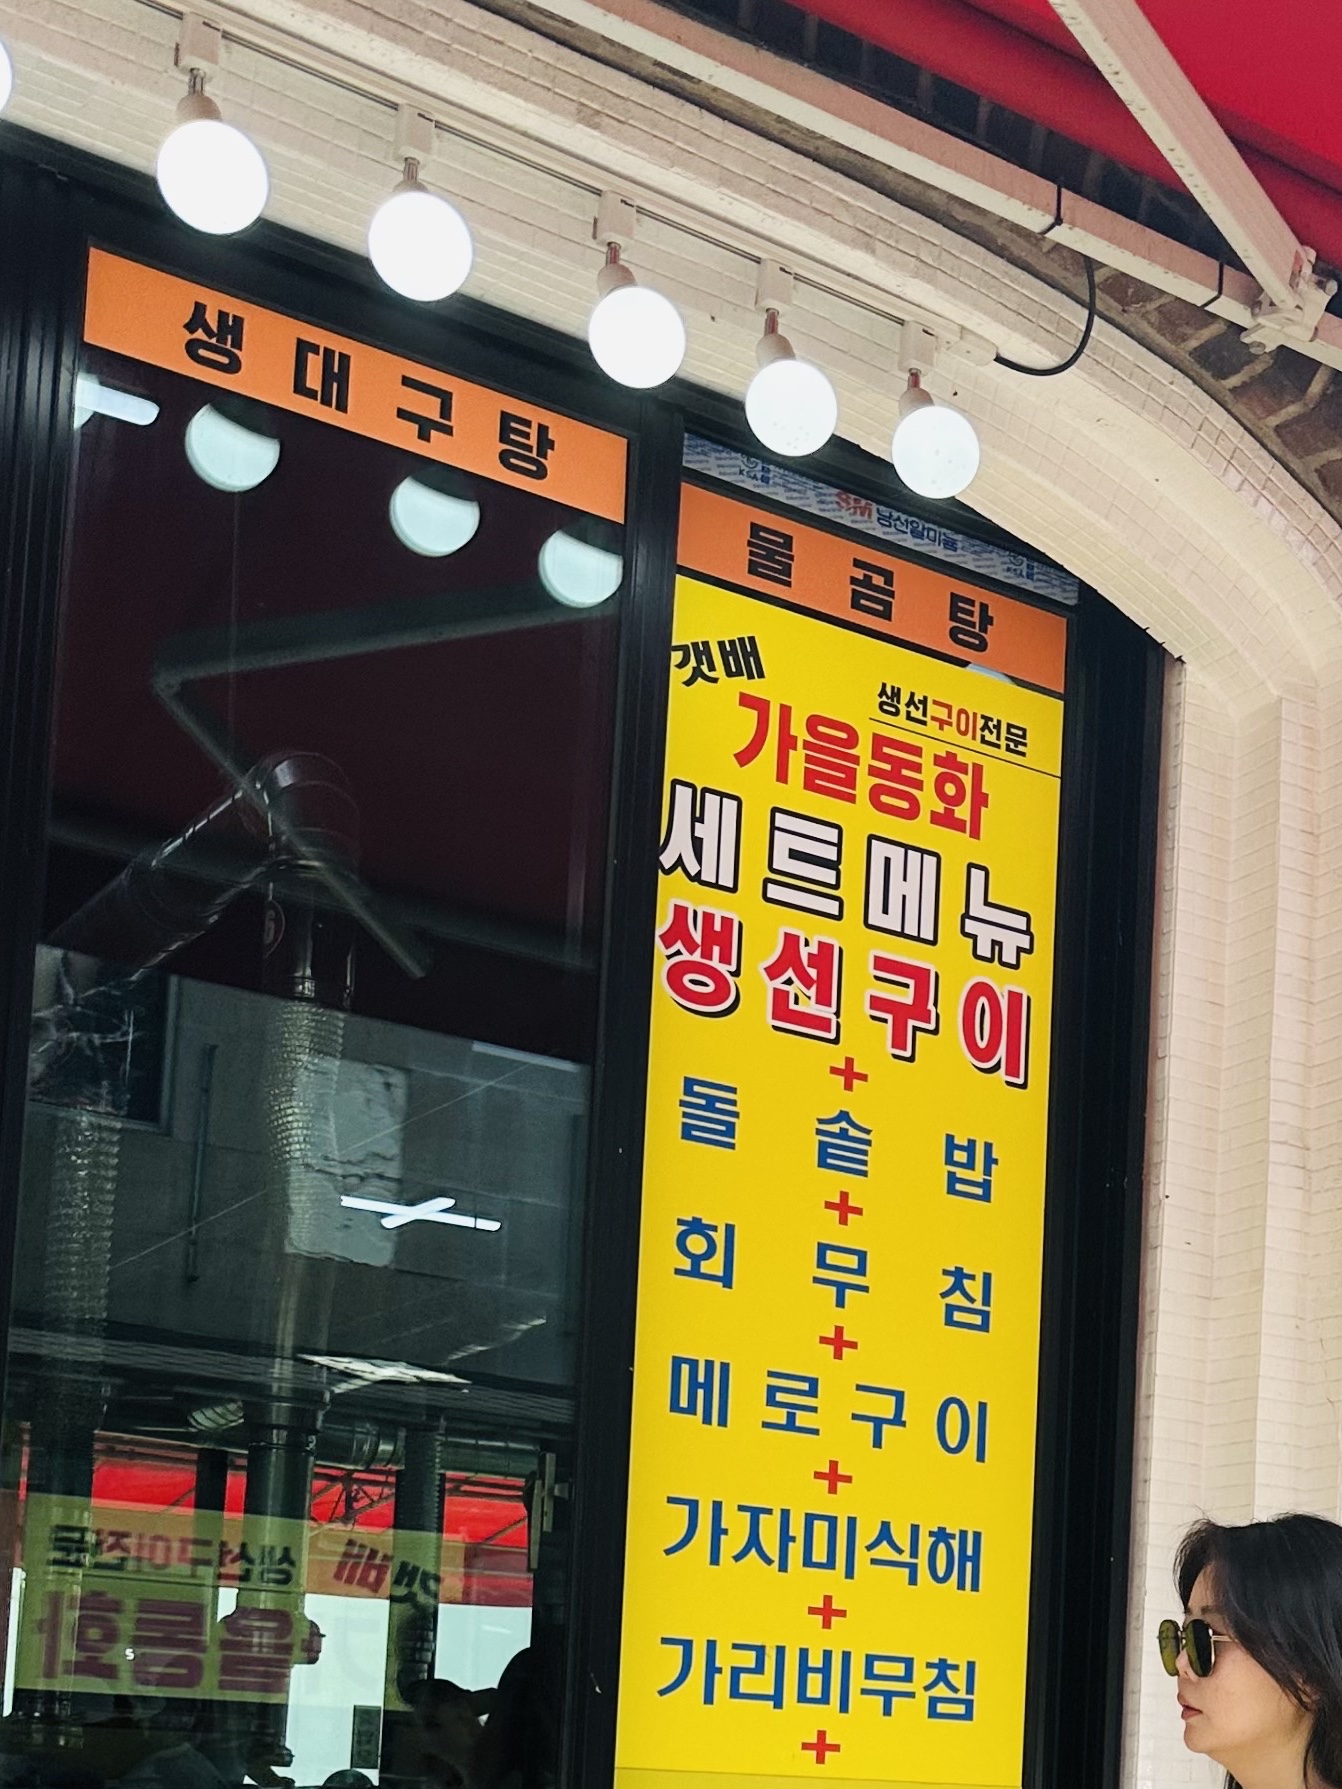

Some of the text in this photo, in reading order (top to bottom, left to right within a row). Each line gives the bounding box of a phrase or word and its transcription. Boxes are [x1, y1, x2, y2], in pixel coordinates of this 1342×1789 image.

[875, 507, 959, 552] 남선알미늄
[671, 636, 766, 686] 갯배
[878, 680, 1029, 757] 생선구이전문
[733, 692, 990, 840] 가을동화
[658, 778, 1034, 966] 세트메뉴
[656, 900, 1029, 1090] 생선구이
[663, 1496, 982, 1592] 가자미식해
[656, 1637, 976, 1722] 가리비무침
